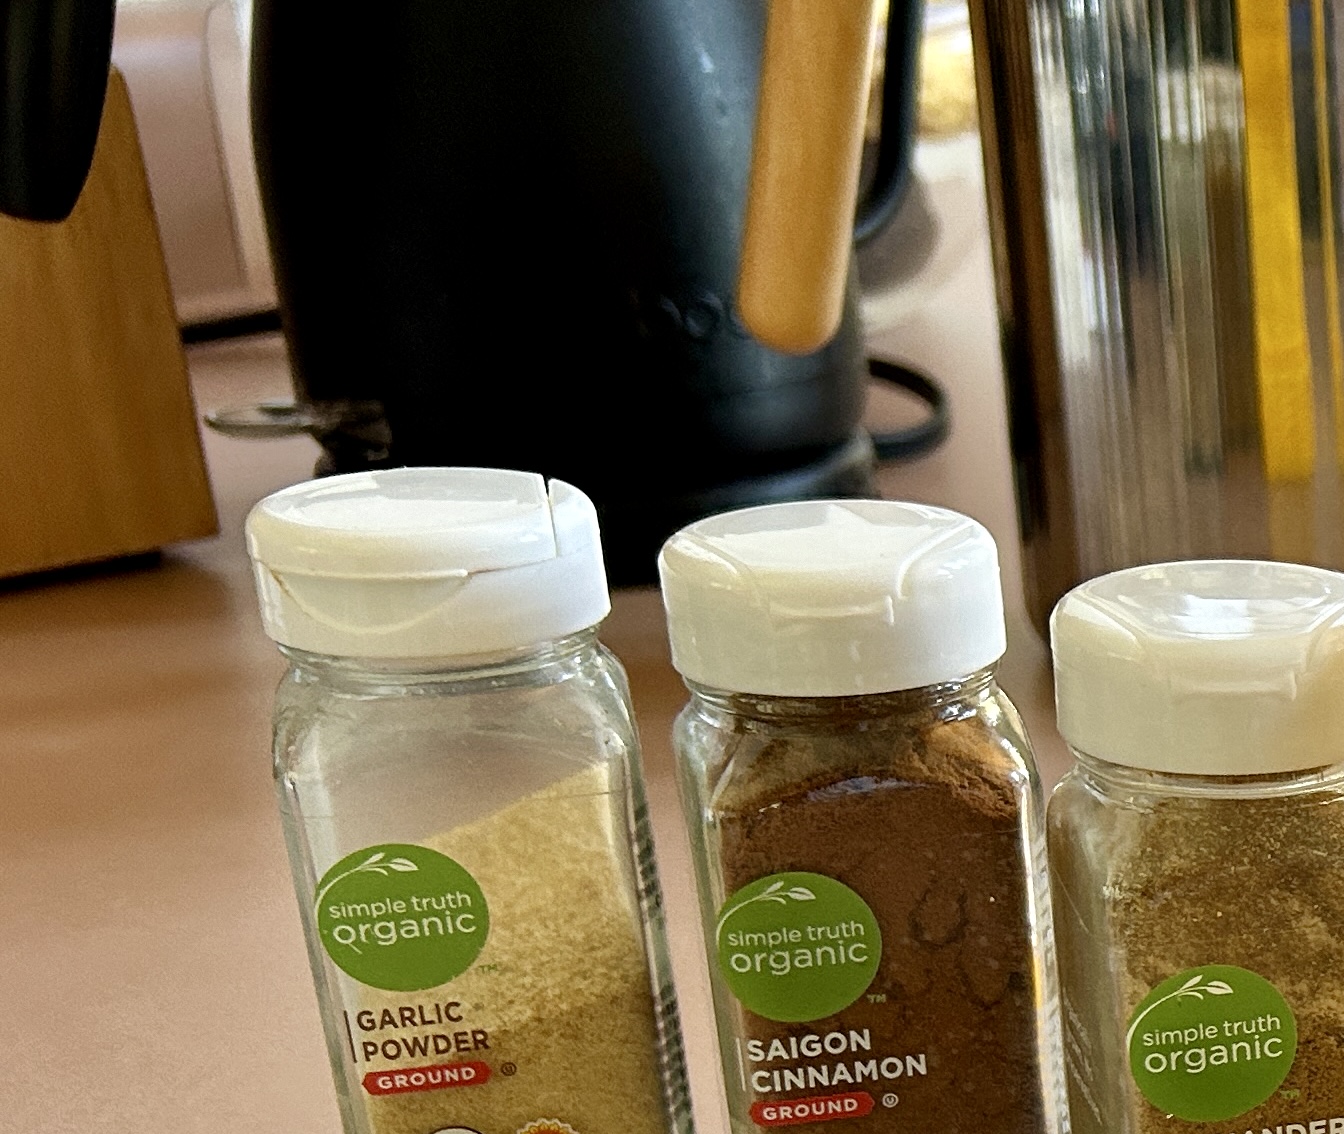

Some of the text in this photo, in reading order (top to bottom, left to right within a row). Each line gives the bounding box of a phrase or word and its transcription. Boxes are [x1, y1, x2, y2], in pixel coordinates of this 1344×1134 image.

[328, 890, 471, 920] simple truth
[332, 911, 477, 946] organic
[728, 920, 865, 947] simple truth
[730, 940, 869, 976] organic
[357, 1001, 464, 1031] GARLIC
[1143, 1014, 1280, 1046] simple truth
[363, 1029, 489, 1061] POWDER
[747, 1029, 871, 1061] SAIGON
[1145, 1034, 1283, 1073] organic
[377, 1067, 476, 1089] GROUND
[752, 1054, 928, 1093] CINNAMON
[763, 1098, 858, 1120] GROUND
